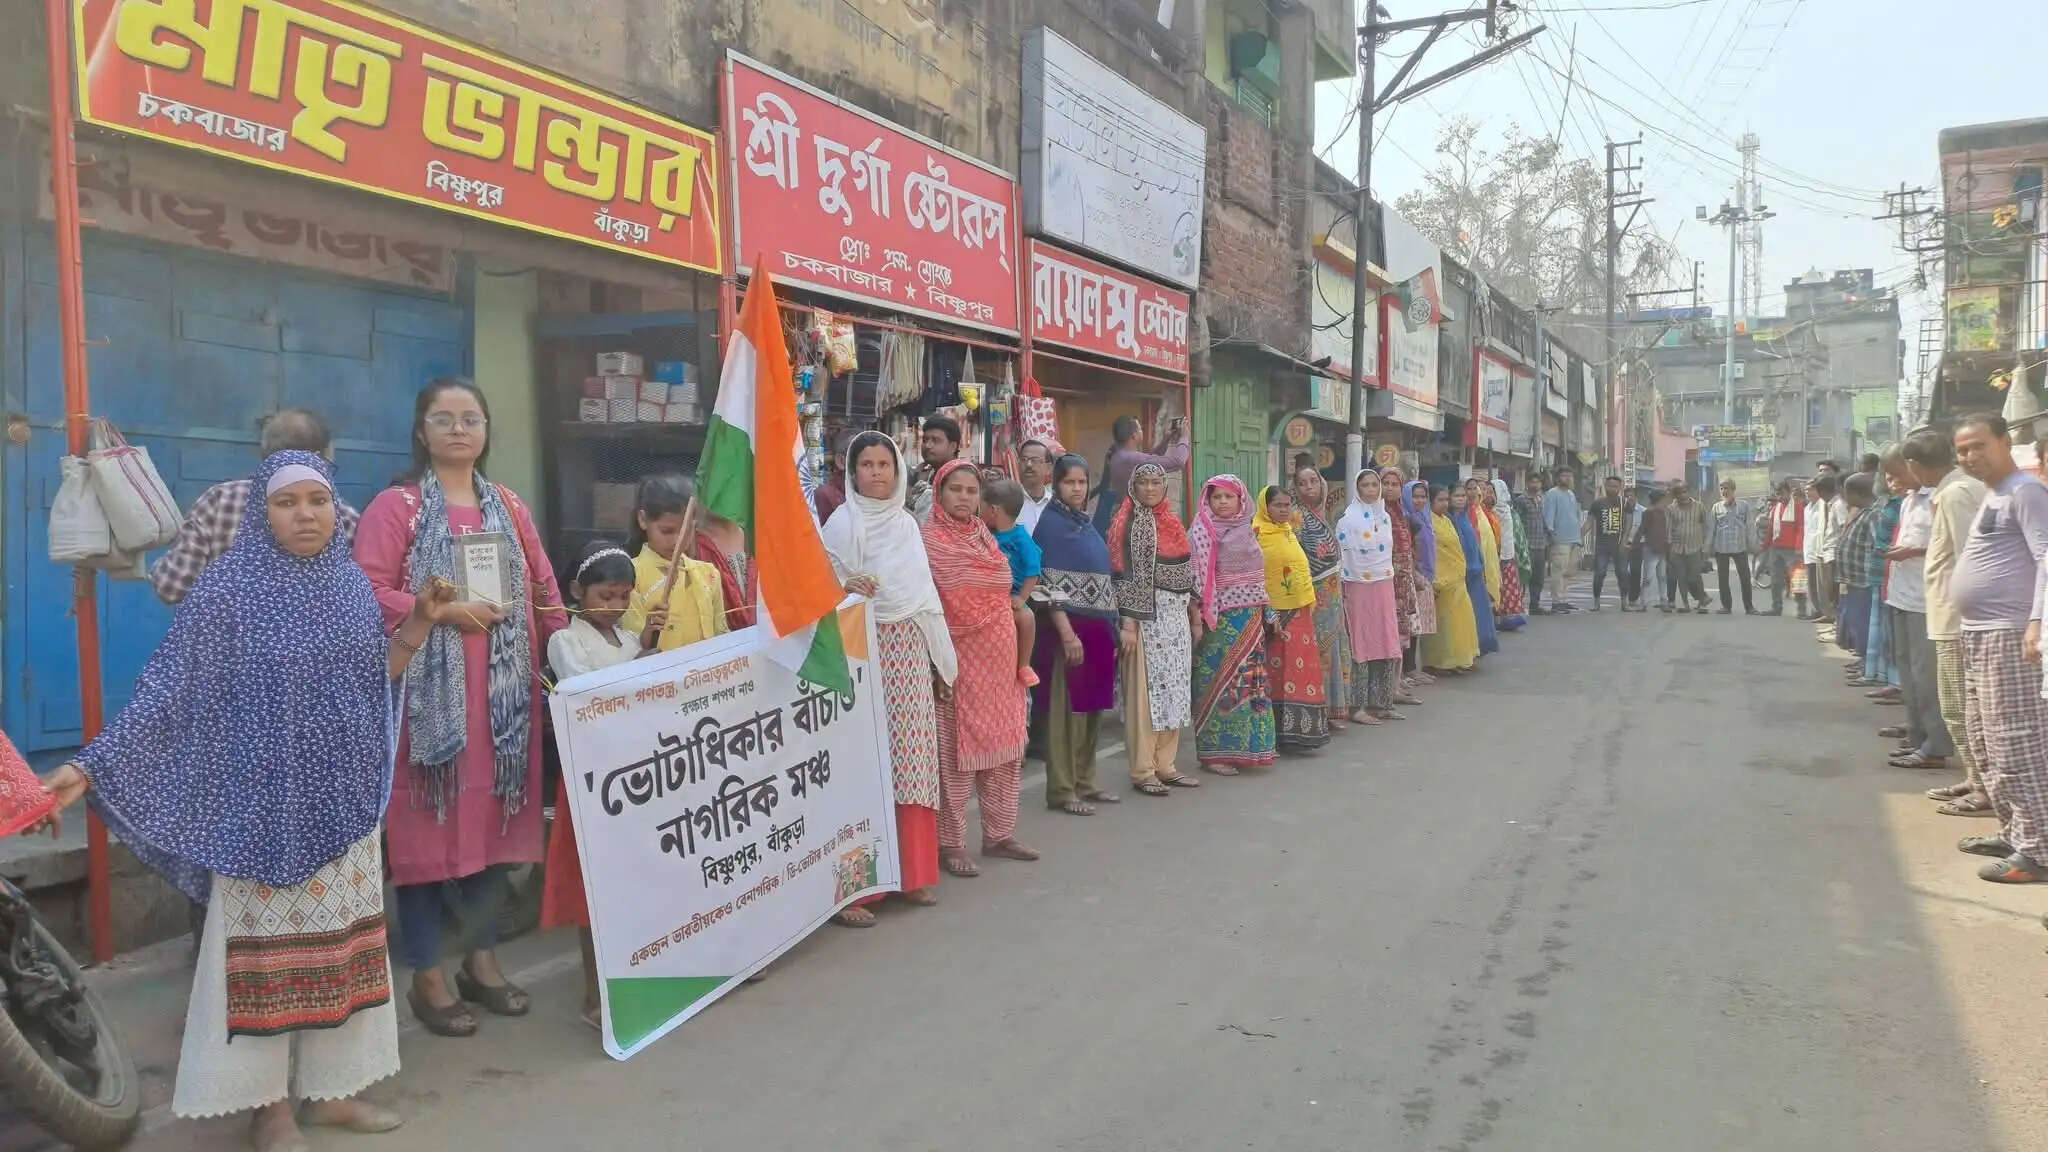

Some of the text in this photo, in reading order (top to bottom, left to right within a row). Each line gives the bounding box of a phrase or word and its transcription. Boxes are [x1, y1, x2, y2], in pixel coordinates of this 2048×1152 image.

[116, 0, 702, 232] মাতৃ ভান্ডার
[138, 92, 651, 247] চকবাজার বিষ্ণুপুর বাঁকুড়া
[743, 92, 800, 190] শ্রী
[813, 137, 892, 226] দুর্গা
[779, 250, 995, 320] চকবাজার বিষ্ণুপুর
[575, 694, 630, 723] সংবিধান,
[711, 687, 736, 706] শপথ
[737, 679, 755, 697] নাও
[656, 749, 831, 860] নাগরিক মঞ্চ
[701, 814, 805, 888] বিষ্ণুপুর, বাঁকুড়া
[629, 935, 669, 967] একজন
